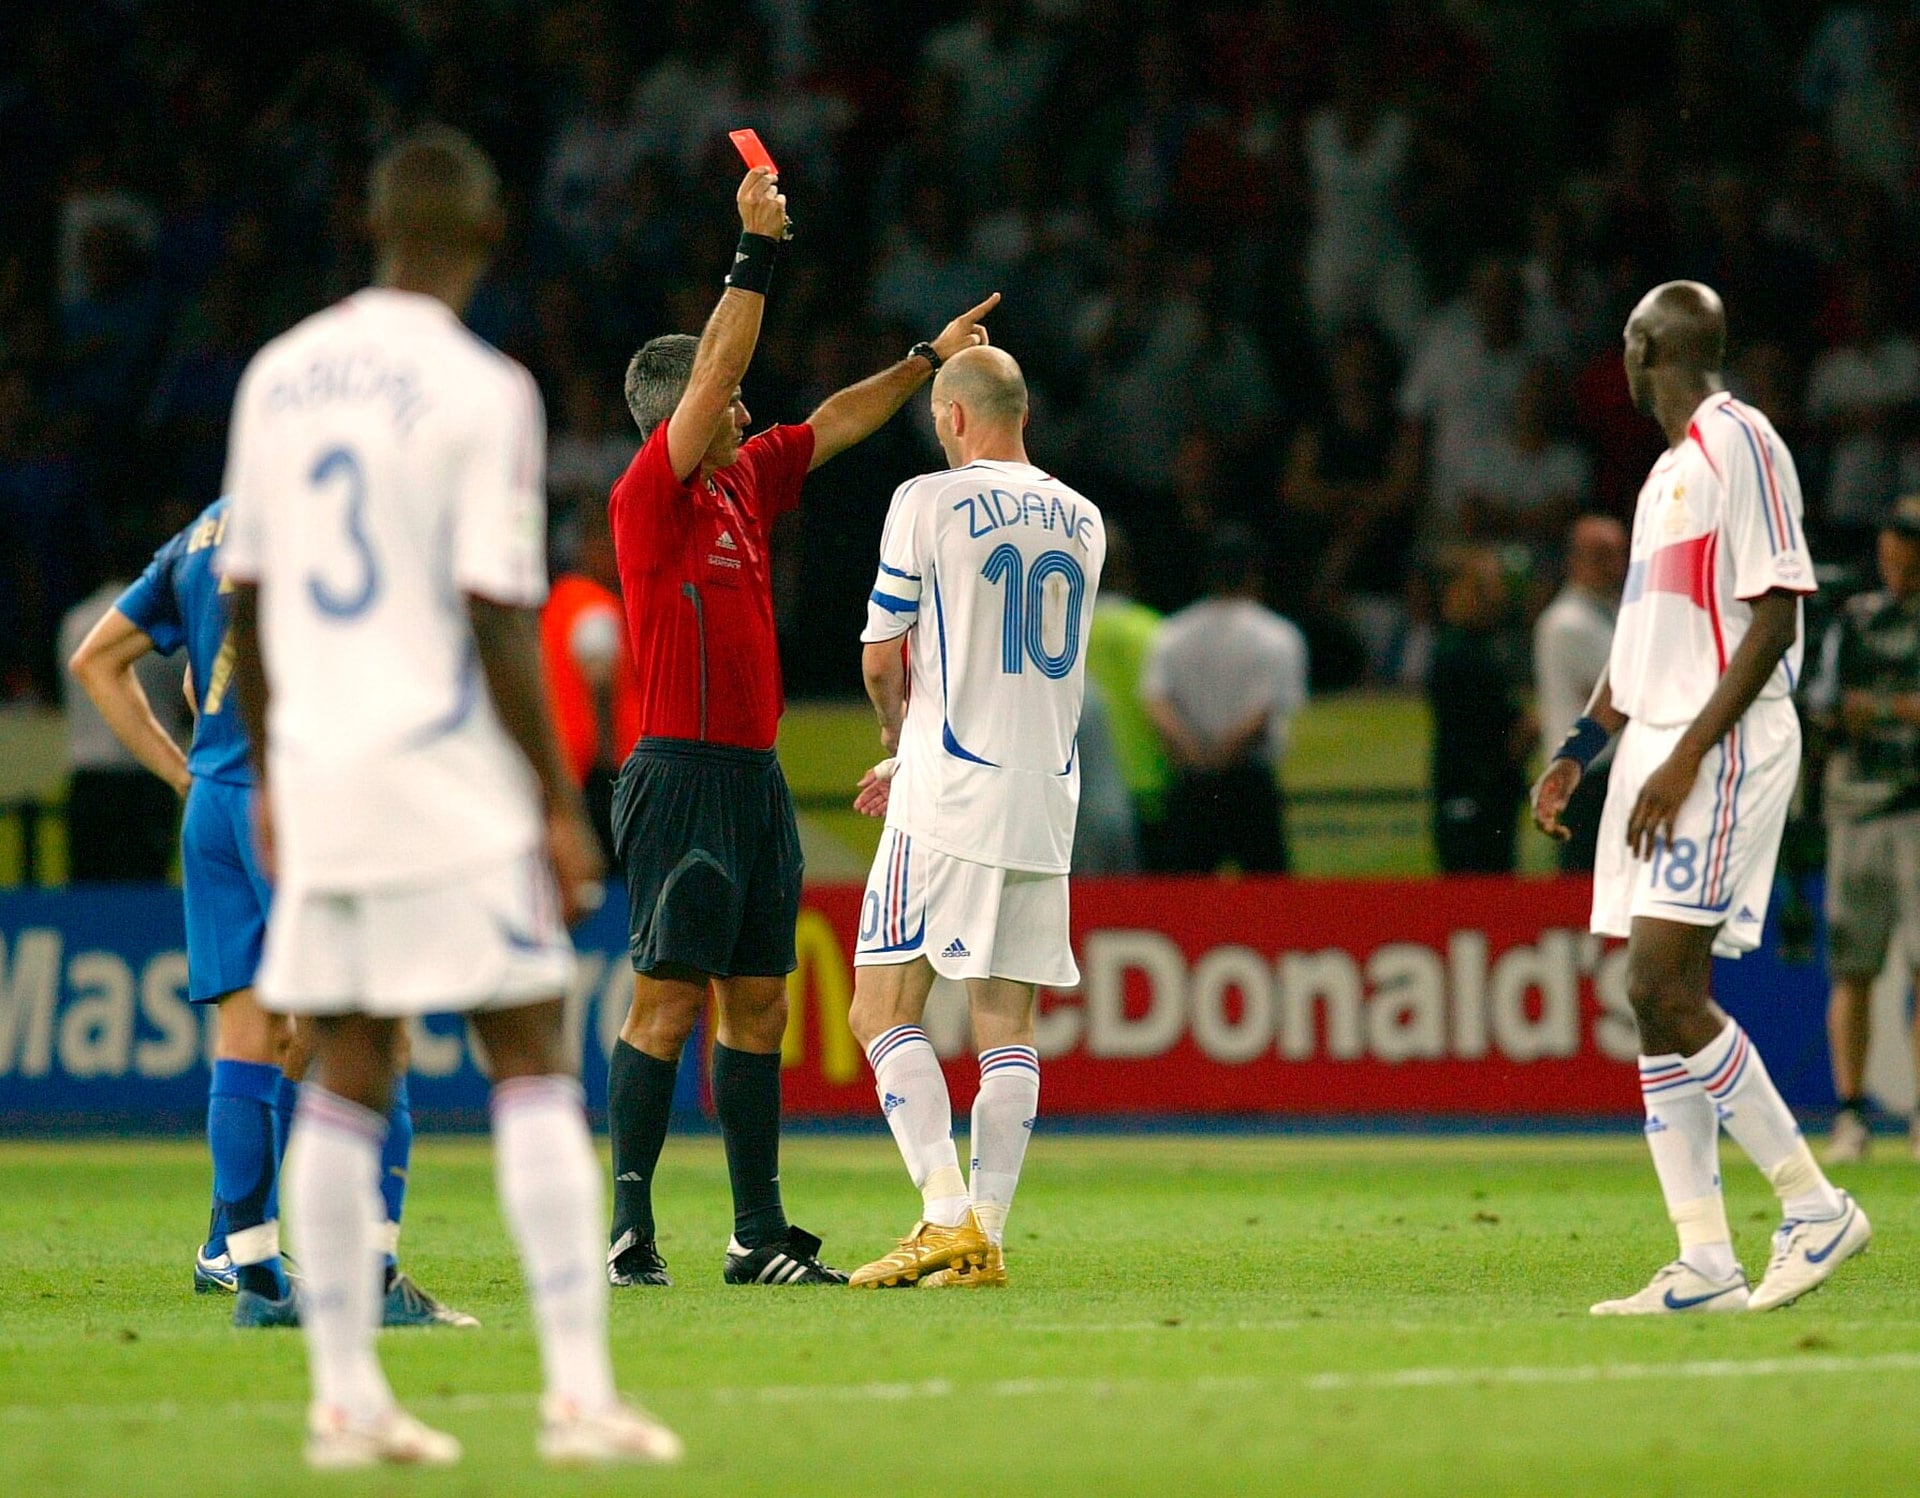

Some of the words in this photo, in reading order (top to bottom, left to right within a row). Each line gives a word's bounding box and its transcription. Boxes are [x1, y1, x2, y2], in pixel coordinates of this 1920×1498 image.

[306, 444, 380, 624] 3
[953, 489, 1094, 551] ZIDANE
[981, 543, 1085, 679] 10
[1651, 837, 1697, 891] 18
